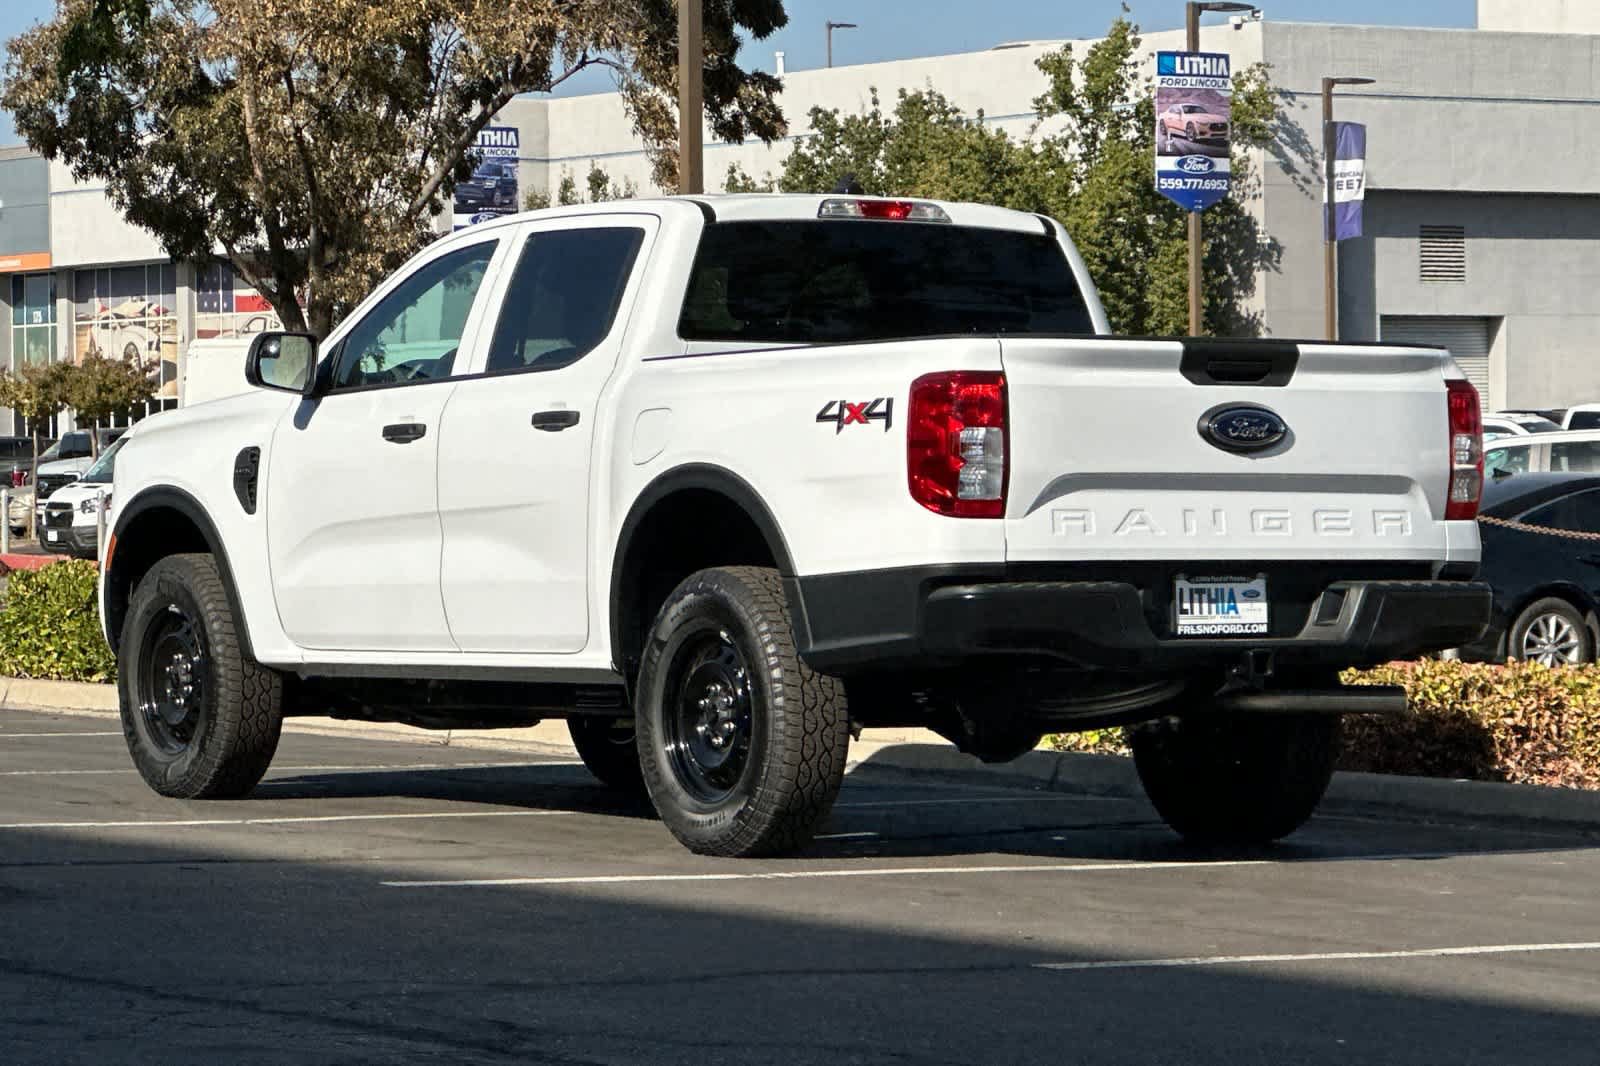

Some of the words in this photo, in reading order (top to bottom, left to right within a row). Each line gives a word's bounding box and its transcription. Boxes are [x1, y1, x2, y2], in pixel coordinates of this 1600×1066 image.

[1175, 56, 1228, 76] LITHIA
[1160, 77, 1188, 87] FORD
[1190, 78, 1228, 88] LINCOLN
[473, 130, 517, 146] ITHIA
[1183, 157, 1209, 173] Ford
[1159, 178, 1228, 190] 559.777.6952
[1336, 178, 1363, 190] EET
[1228, 416, 1270, 439] Ford
[1051, 508, 1413, 537] RANGER
[1178, 587, 1239, 615] LITHIA
[1177, 624, 1268, 635] FRESNOFORD.COM
